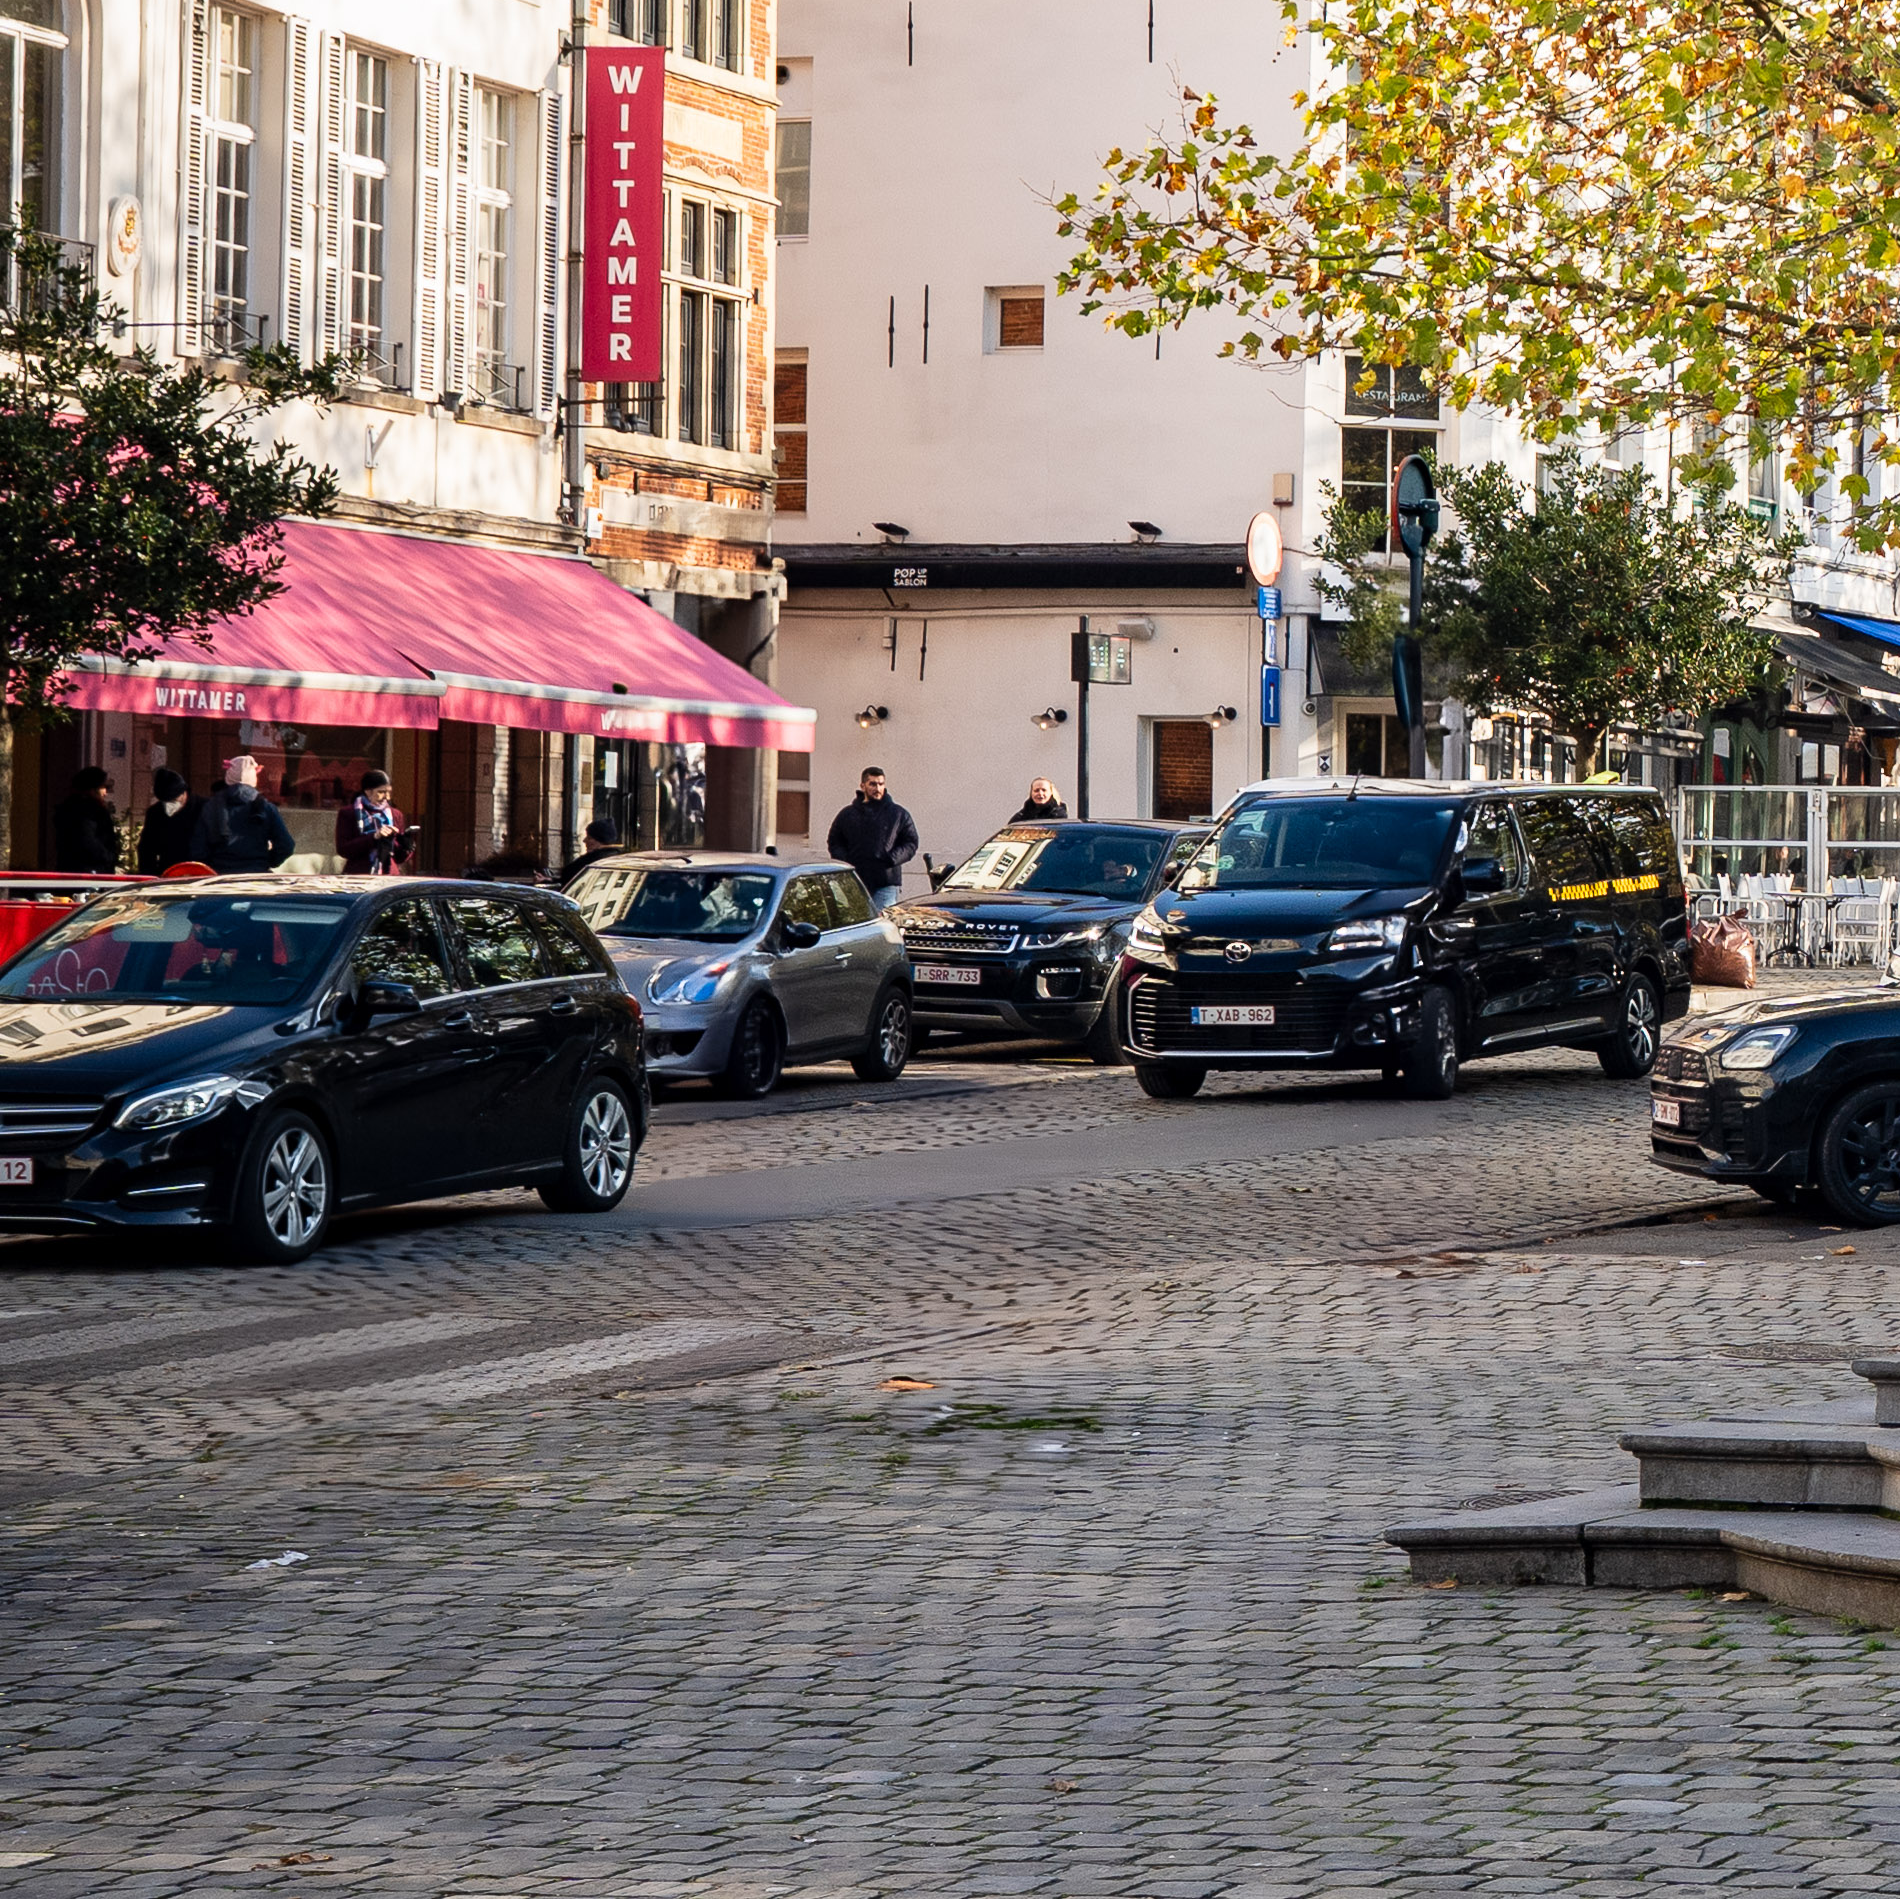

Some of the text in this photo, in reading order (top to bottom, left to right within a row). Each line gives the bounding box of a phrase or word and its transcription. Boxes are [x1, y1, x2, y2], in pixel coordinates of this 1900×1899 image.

[607, 64, 644, 362] WITTAMER
[893, 578, 927, 587] SABLON
[155, 686, 246, 712] WITTAMER
[905, 918, 1020, 931] RANGE ROVER
[916, 967, 979, 983] 1-SRR-733
[1200, 1009, 1272, 1022] T-XAB-962
